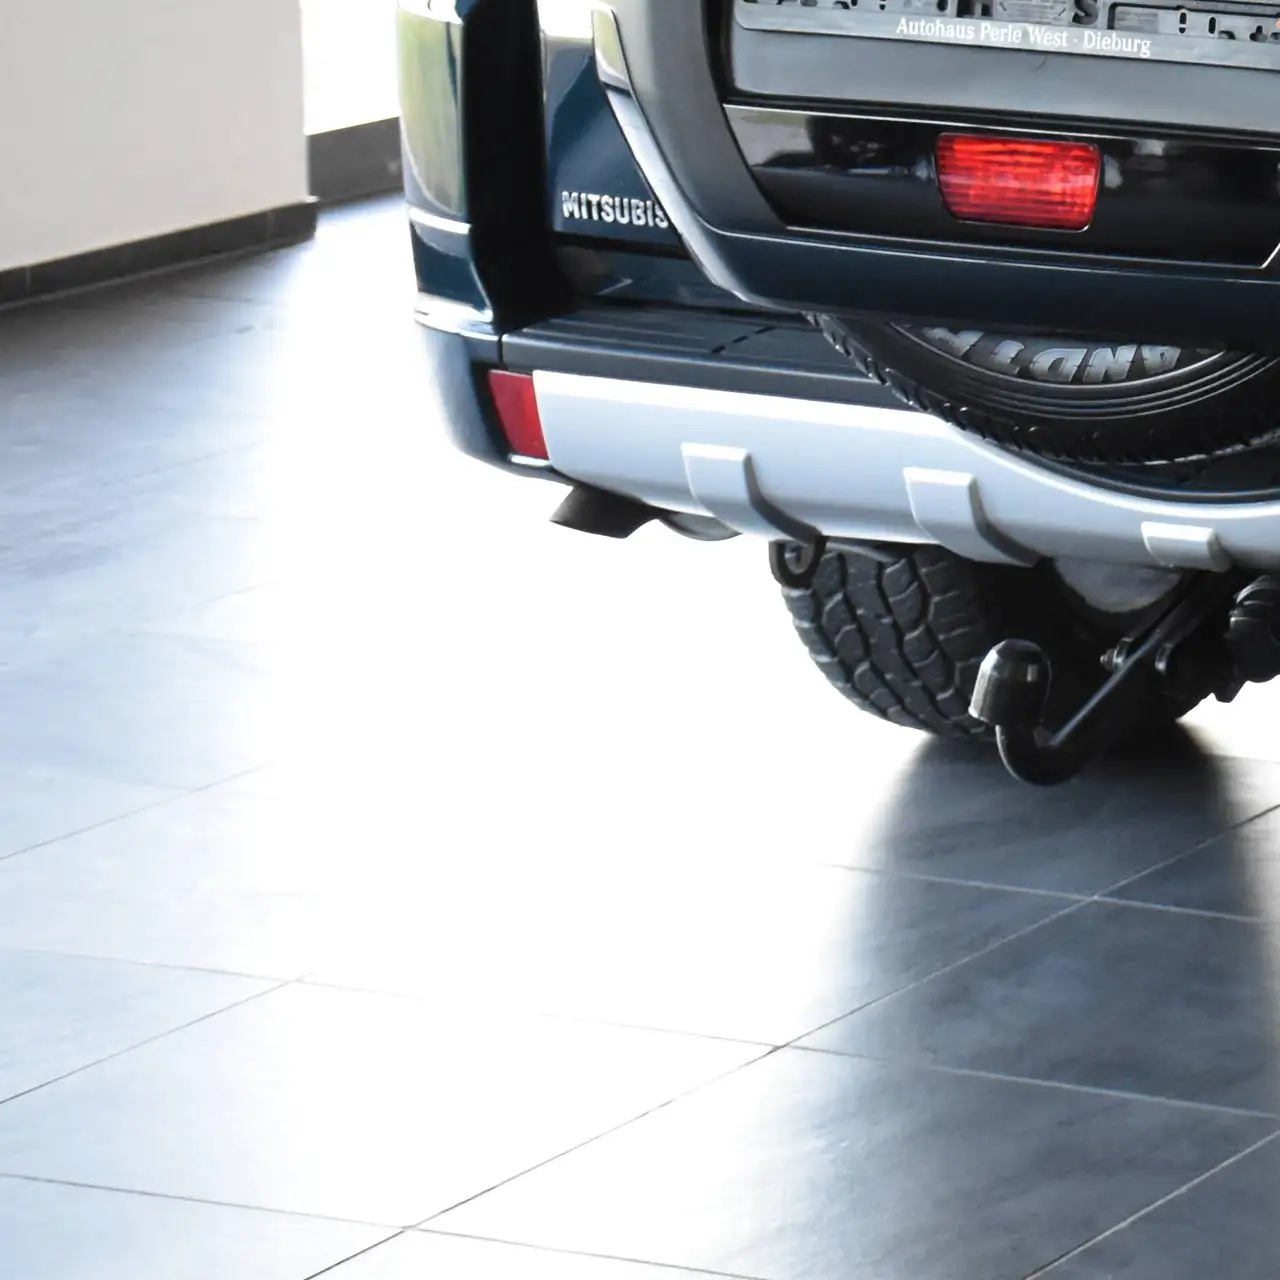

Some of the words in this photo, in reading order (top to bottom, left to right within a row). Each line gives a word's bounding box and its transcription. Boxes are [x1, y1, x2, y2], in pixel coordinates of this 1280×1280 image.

[896, 17, 975, 41] Autohaus
[979, 23, 1022, 45] Perle
[1028, 25, 1068, 48] West
[1083, 31, 1152, 57] Dieburg
